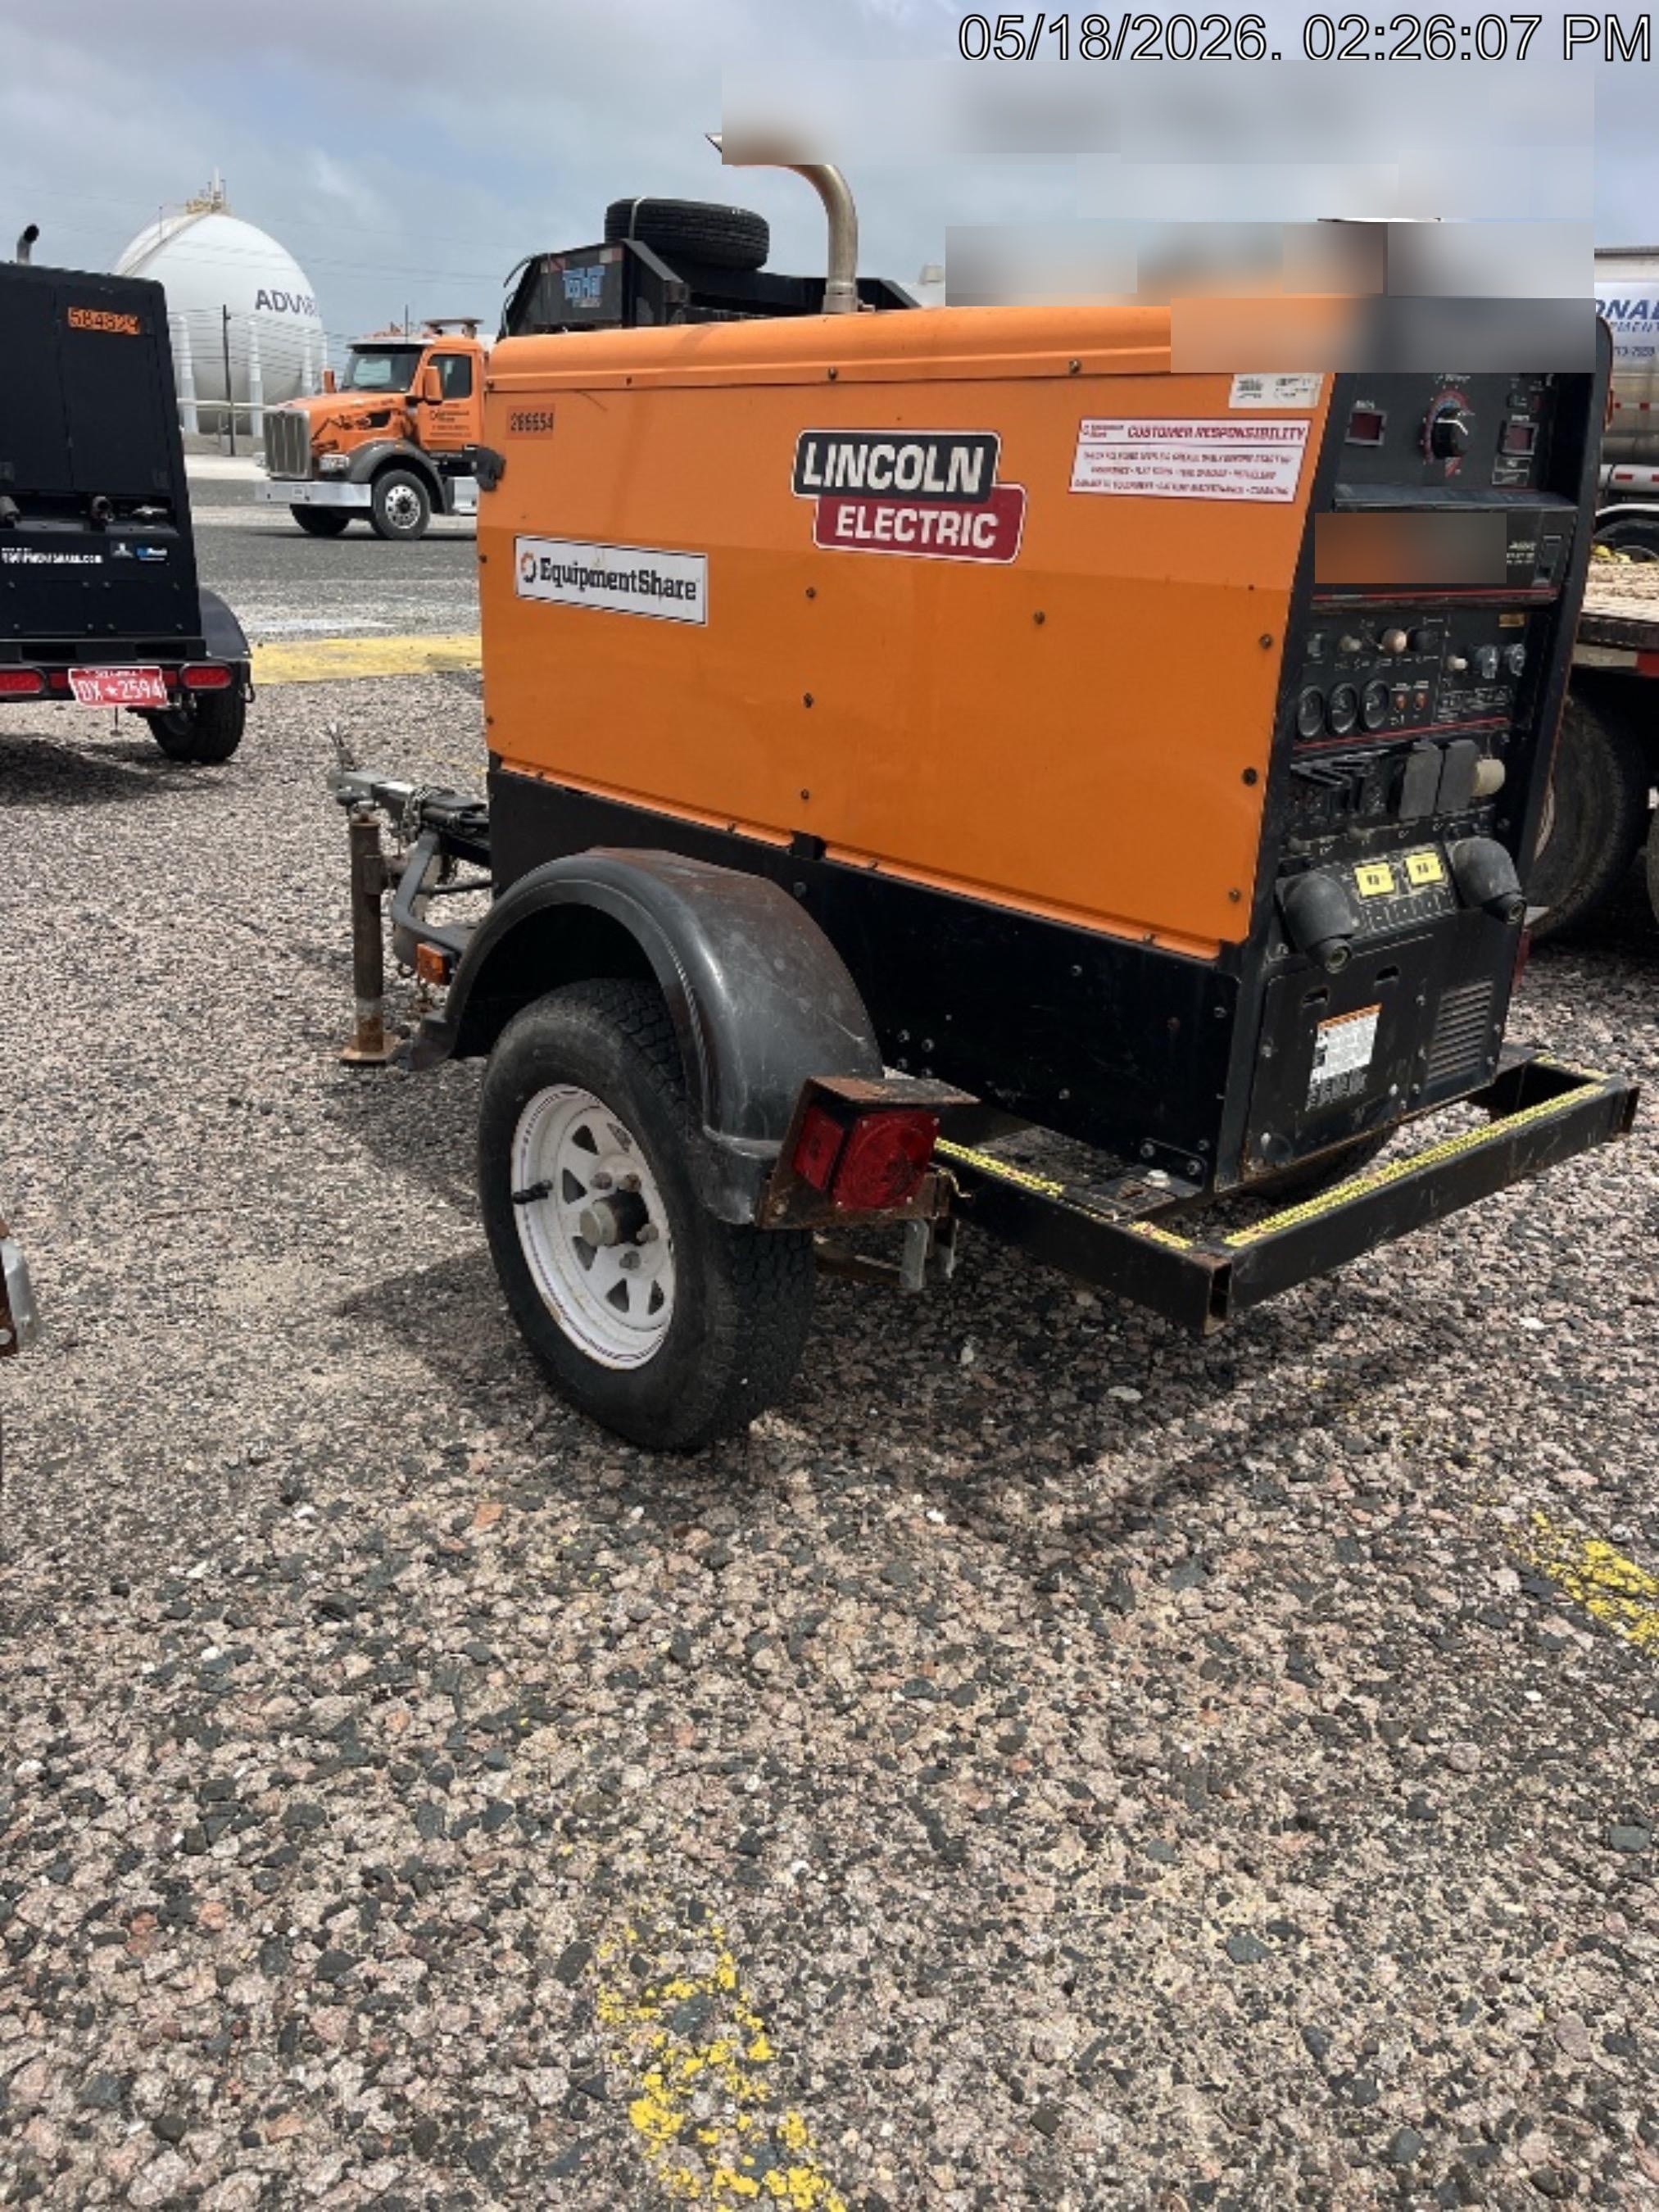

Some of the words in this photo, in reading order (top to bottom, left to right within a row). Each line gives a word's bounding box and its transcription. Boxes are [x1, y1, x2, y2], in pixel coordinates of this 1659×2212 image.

[1127, 425, 1193, 438] CUSTOMER
[1194, 427, 1306, 441] RESPONSIBILITY
[803, 442, 983, 494] LINCOLN
[835, 504, 999, 549] ELECTRIC
[540, 557, 696, 600] EquipmentShare
